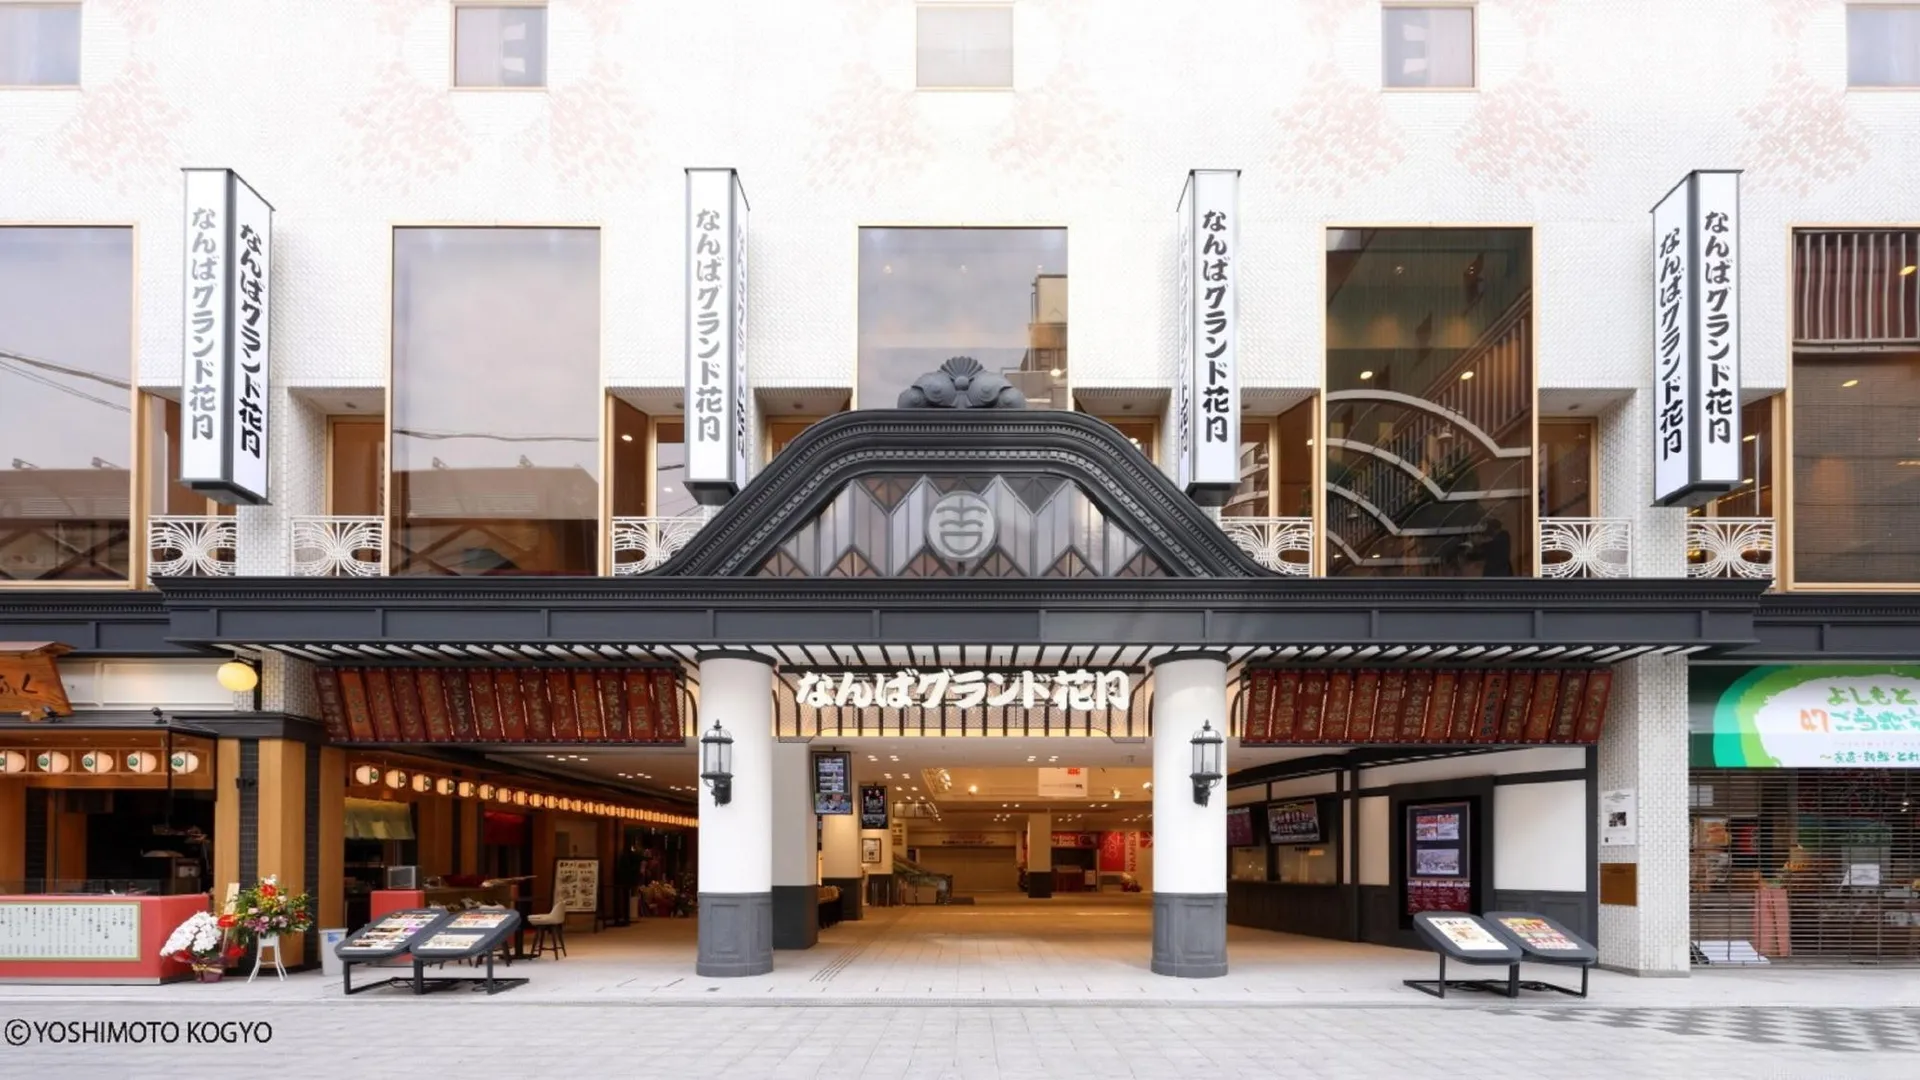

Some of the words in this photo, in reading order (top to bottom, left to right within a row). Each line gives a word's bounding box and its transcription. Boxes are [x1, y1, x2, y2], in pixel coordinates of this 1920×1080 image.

[189, 207, 219, 441] なんばグランド花月
[238, 223, 262, 460] なんばグランド花月
[695, 207, 723, 443] なんばグランド花月
[1202, 209, 1231, 444] なんばグランド花月
[1659, 228, 1684, 461] なんばグランド花月
[1704, 211, 1733, 445] なんばグランド花月
[796, 668, 1131, 711] なんばグランド花月
[1826, 685, 1918, 706] よしもと
